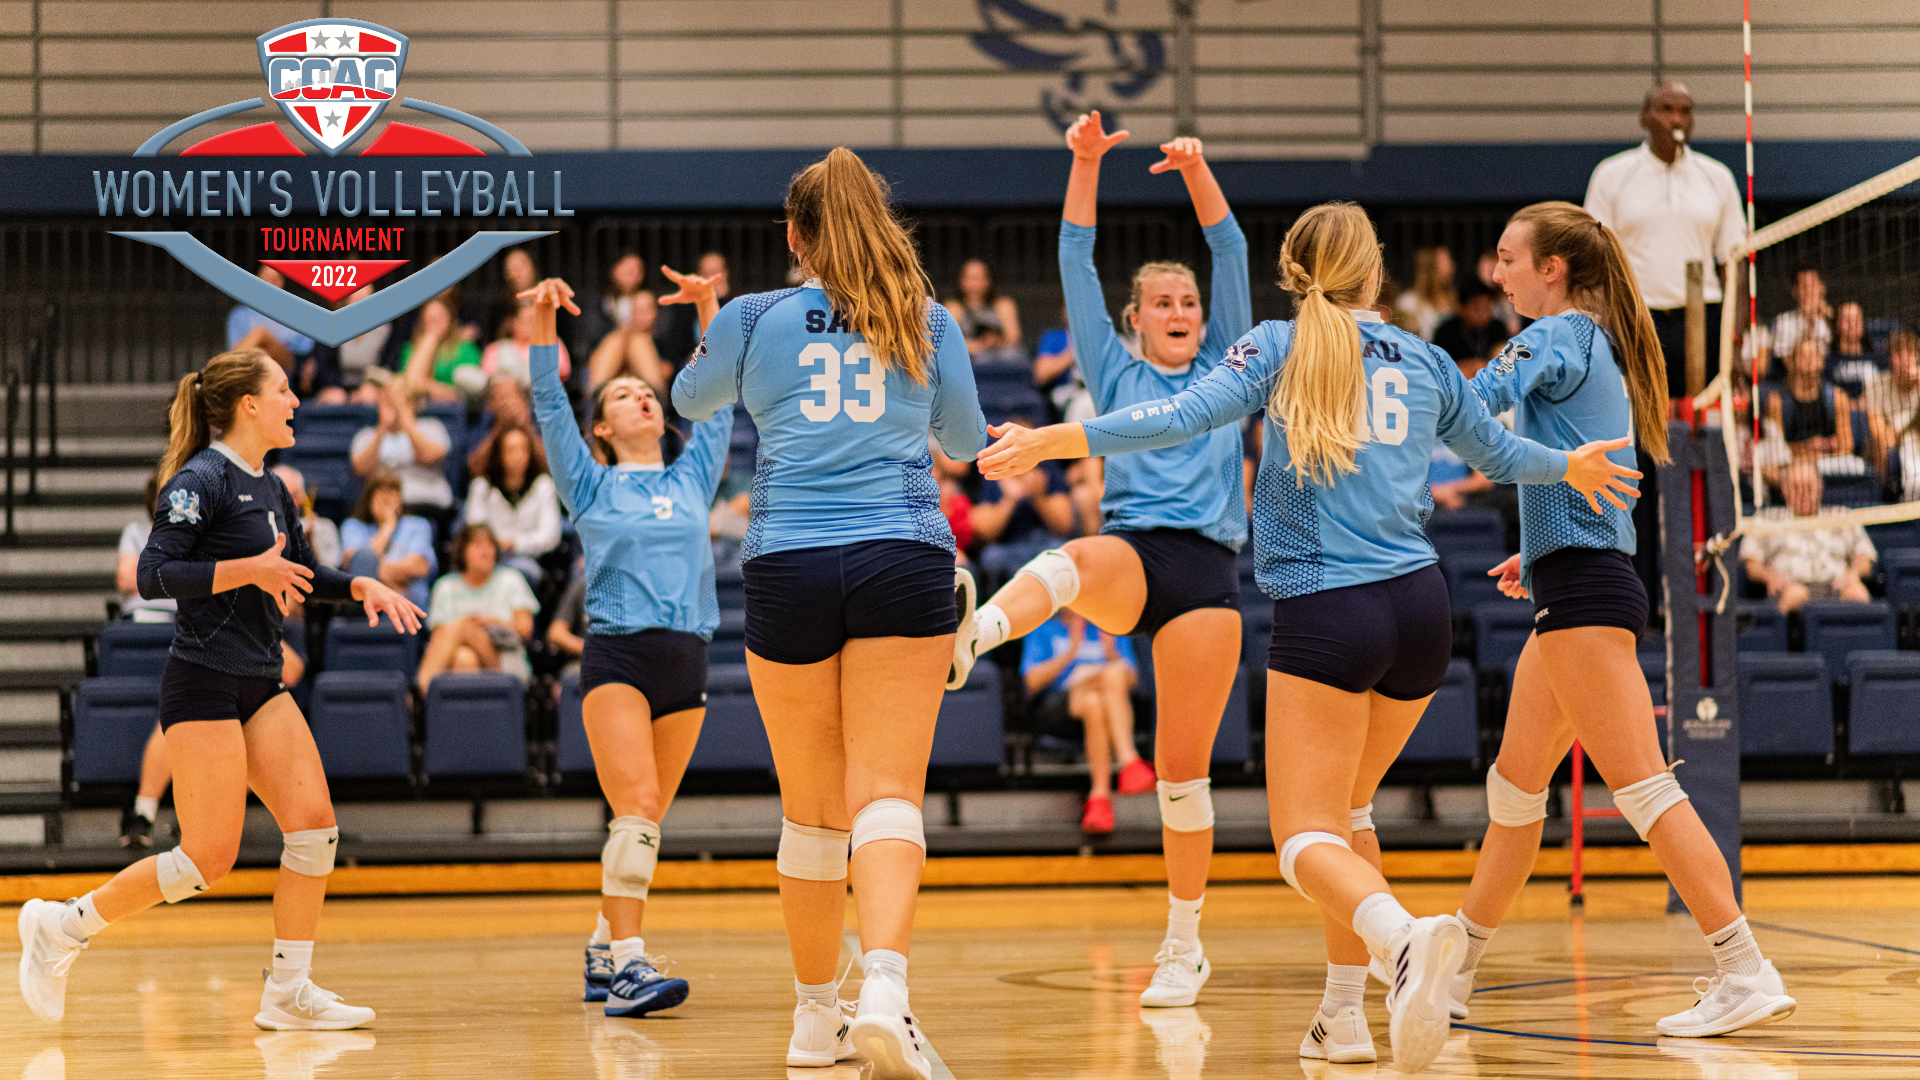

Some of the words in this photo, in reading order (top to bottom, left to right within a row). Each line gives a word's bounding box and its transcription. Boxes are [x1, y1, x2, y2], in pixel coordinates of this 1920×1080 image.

[805, 309, 860, 334] SA
[1362, 340, 1402, 363] AU
[798, 342, 886, 423] 33
